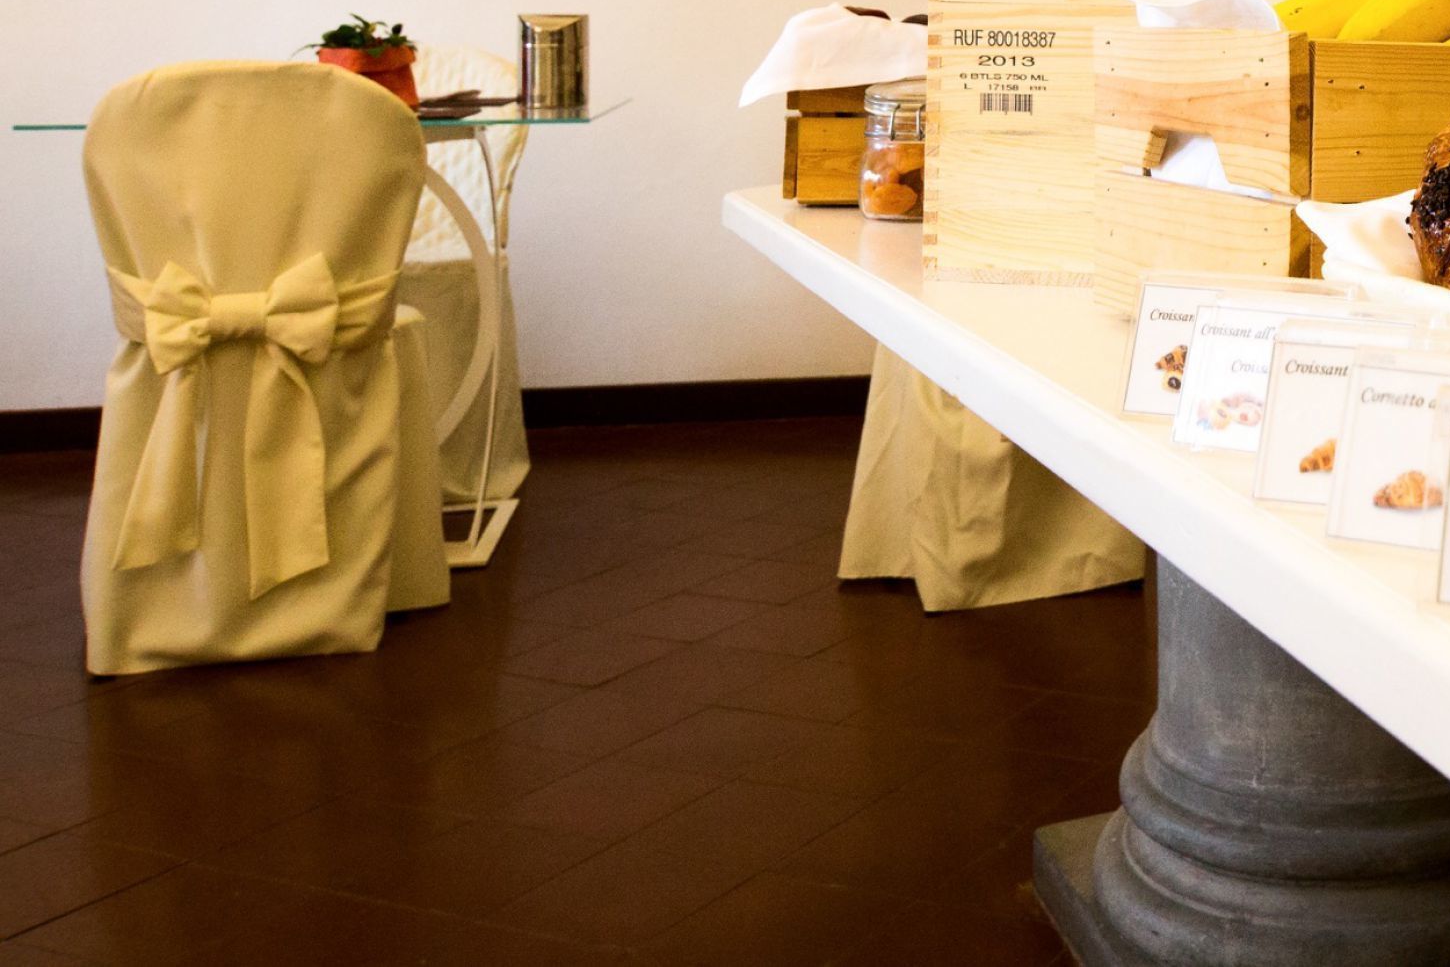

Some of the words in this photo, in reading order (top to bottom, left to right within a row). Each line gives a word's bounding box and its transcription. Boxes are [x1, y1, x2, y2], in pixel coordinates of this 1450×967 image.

[954, 29, 984, 46] RUF
[987, 30, 1056, 48] 80018387
[978, 55, 1035, 67] 2013
[1201, 323, 1252, 339] Croissant
[1285, 359, 1349, 377] Croissant
[1361, 386, 1425, 408] Cornetto
